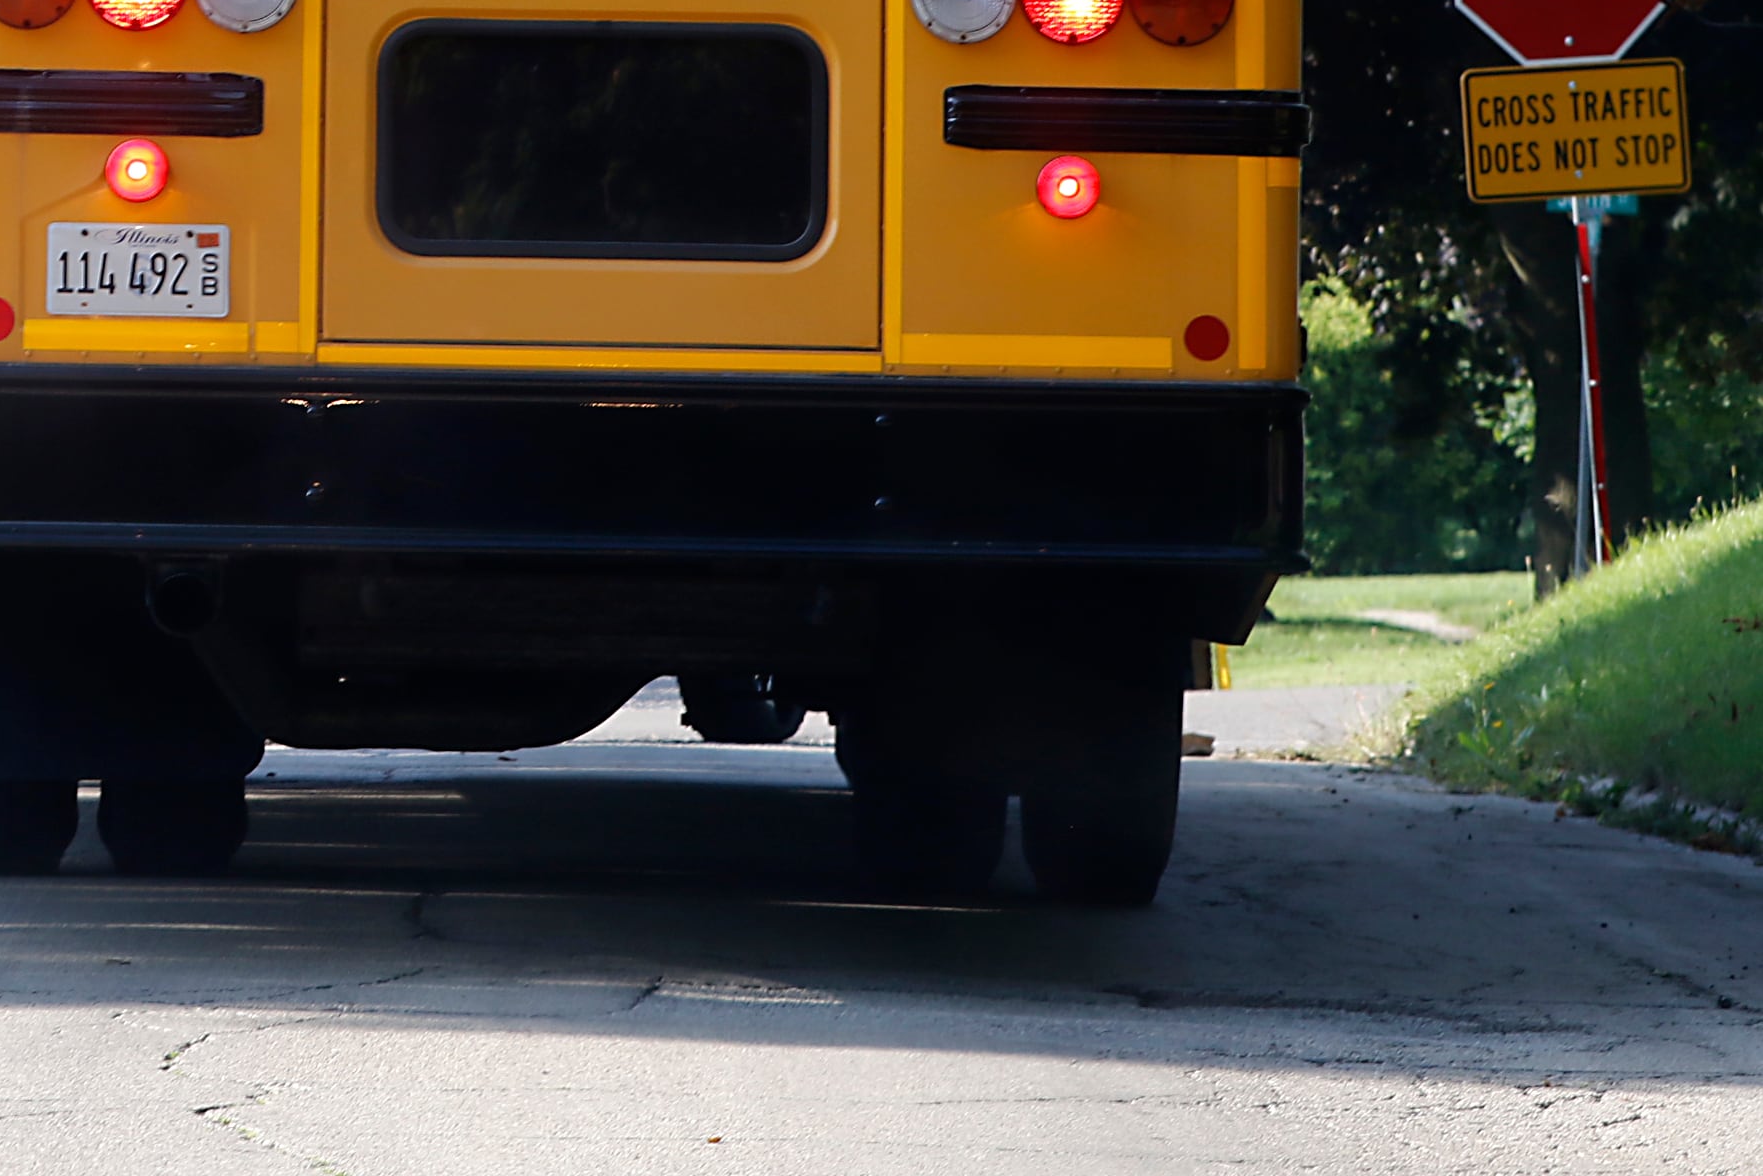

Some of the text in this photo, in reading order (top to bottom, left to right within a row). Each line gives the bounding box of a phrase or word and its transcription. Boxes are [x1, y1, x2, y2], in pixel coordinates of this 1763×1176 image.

[1477, 87, 1672, 128] CROSS TRAFFIC
[1478, 133, 1677, 175] DOES NOT STOP
[102, 228, 179, 244] Illinois
[56, 251, 189, 295] 114 492
